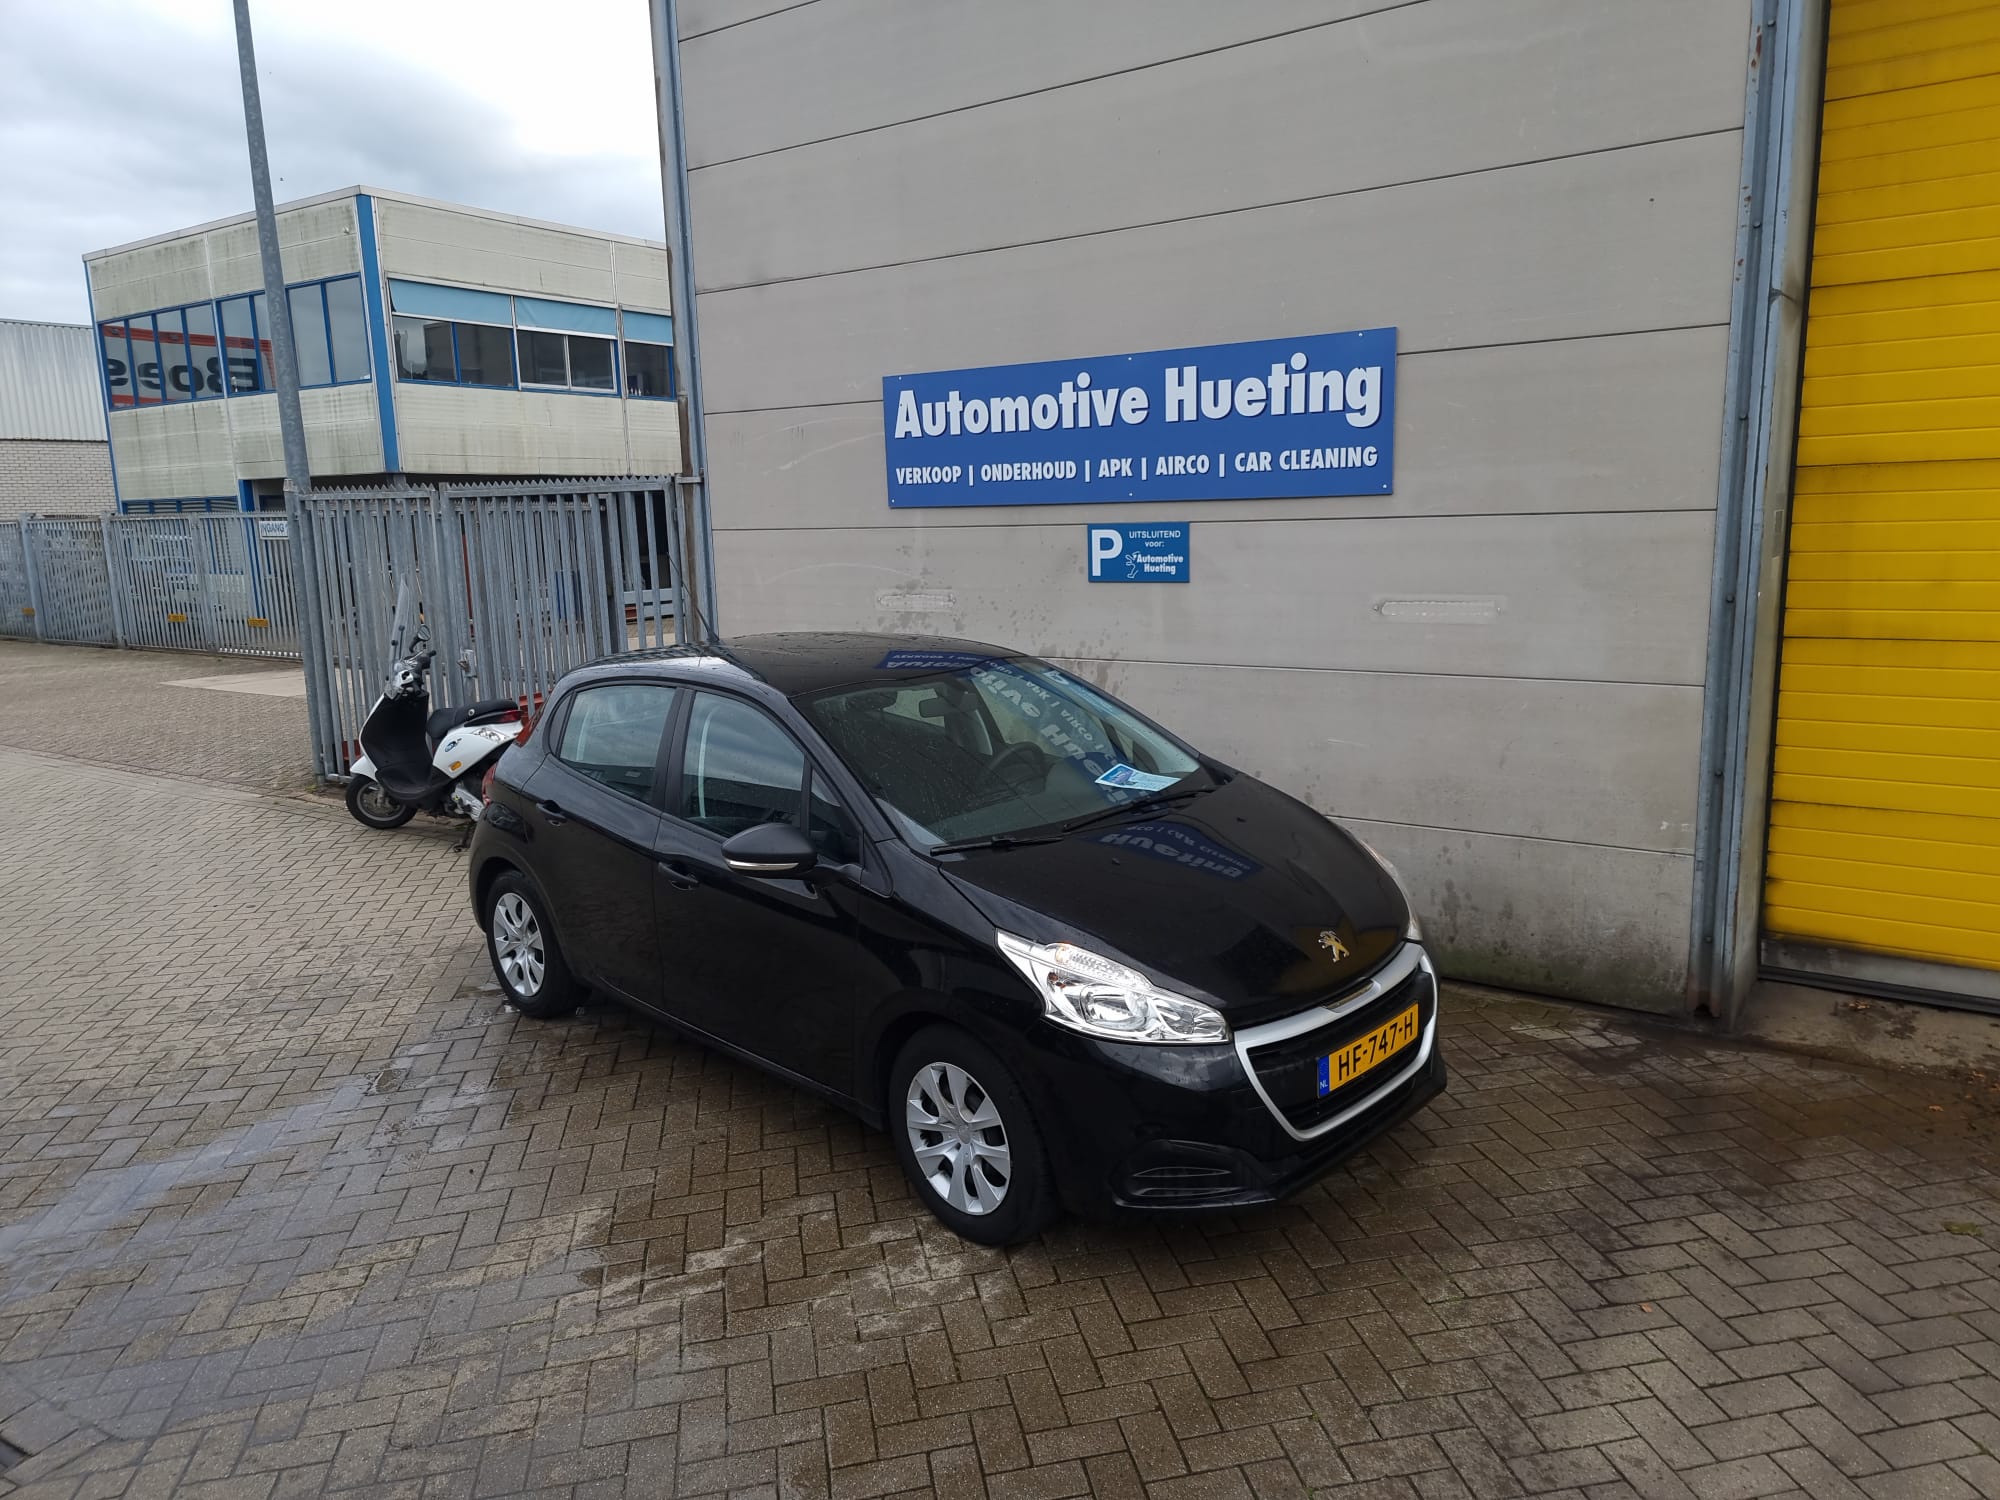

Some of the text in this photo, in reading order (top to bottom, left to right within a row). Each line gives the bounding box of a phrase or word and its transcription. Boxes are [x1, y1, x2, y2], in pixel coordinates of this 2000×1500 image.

[895, 353, 1381, 438] Automotive Hueting
[895, 465, 962, 485] VERKOOP
[980, 460, 1077, 482] ONDERHOUD
[1098, 457, 1133, 478] APK
[1155, 454, 1210, 476] AIRCO
[1234, 451, 1272, 472] CAR
[1279, 446, 1378, 470] CLEANING
[1092, 529, 1123, 577] P
[1128, 530, 1182, 539] UITSLUITEND
[1136, 553, 1184, 563] Automotive
[1144, 562, 1176, 575] Hueting
[1338, 1012, 1413, 1081] HF-747-H
